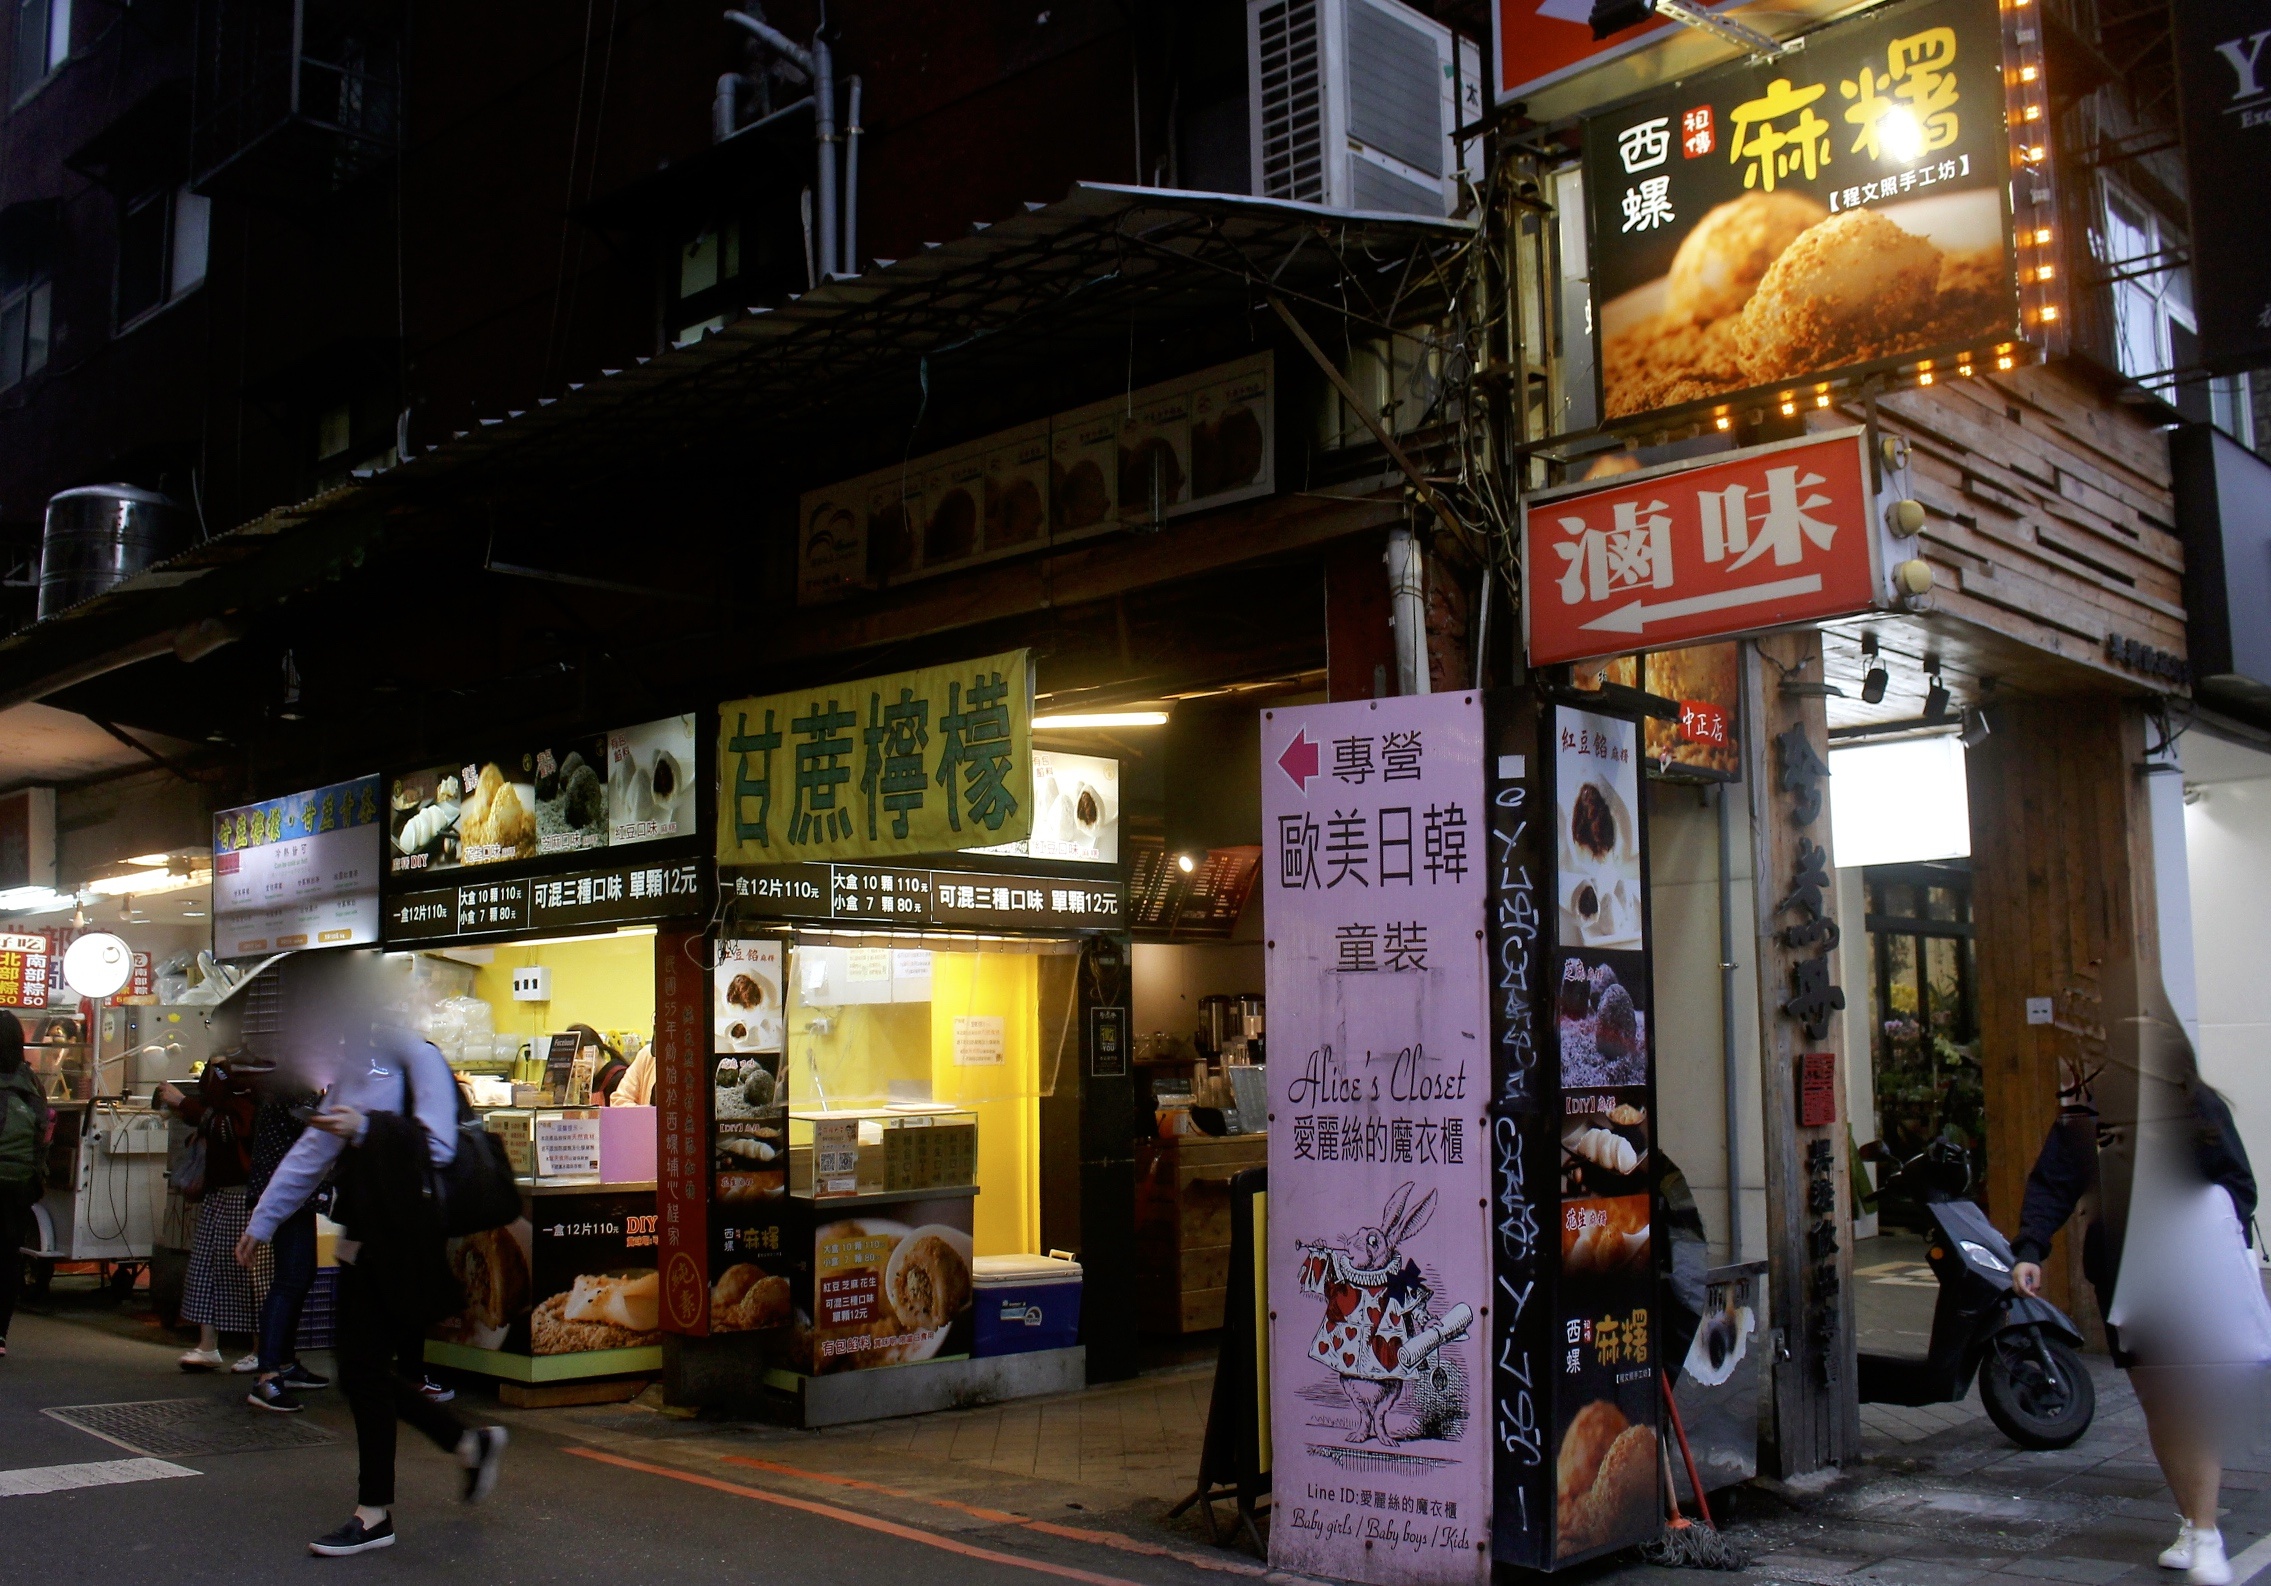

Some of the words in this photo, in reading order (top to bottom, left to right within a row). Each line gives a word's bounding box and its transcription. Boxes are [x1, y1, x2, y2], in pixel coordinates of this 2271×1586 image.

[1730, 27, 1959, 192] 麻糬
[1684, 110, 1711, 154] 祖傳
[1618, 117, 1675, 233] 西螺
[1554, 465, 1837, 606] 滷味
[1683, 707, 1723, 742] 中正店
[1332, 731, 1423, 784] 專營
[1562, 727, 1607, 760] 紅豆餡
[727, 672, 1018, 849] 甘蔗檸檬
[411, 853, 428, 869] DIY
[1277, 803, 1468, 890] 歐美日韓
[461, 890, 476, 906] 大盒
[479, 890, 488, 903] 10
[490, 887, 498, 902] 顆
[501, 886, 521, 901] 110元
[535, 874, 622, 909] 可混三種口味
[629, 866, 697, 899] 單顆12元
[834, 872, 858, 891] 大盒
[863, 875, 877, 889] 10
[881, 875, 893, 892] 顆
[898, 876, 928, 894] 110元
[939, 883, 1043, 912] 可混三種口味
[1051, 889, 1118, 915] 單顆12元
[393, 903, 447, 924] 一盒12片110元
[460, 908, 475, 925] 小盒
[480, 909, 485, 923] 7
[490, 906, 498, 921] 顆
[499, 906, 516, 920] 80元
[834, 894, 858, 912] 小盒
[866, 896, 873, 911] 7
[882, 895, 893, 912] 顆
[898, 896, 921, 913] 80元
[1335, 922, 1429, 974] 童裝
[23, 954, 47, 996] 南部粽
[23, 997, 44, 1006] 50
[1288, 1046, 1380, 1109] Alice's
[1391, 1043, 1466, 1101] Closet
[1294, 1115, 1463, 1165] 愛麗絲的魔衣櫃
[543, 1222, 619, 1236] 一盒12片110元
[627, 1215, 658, 1234] DIY
[1566, 1209, 1587, 1231] 花生
[823, 1281, 840, 1292] 紅豆
[860, 1277, 877, 1288] 花生
[826, 1294, 875, 1309] 可混三種口味
[832, 1308, 868, 1322] 單顆12元
[822, 1334, 872, 1356] 有包餡料
[1566, 1319, 1582, 1374] 西螺
[1595, 1308, 1648, 1366] 麻糬
[1307, 1483, 1335, 1501] Line
[1291, 1508, 1324, 1539] Baby
[1327, 1514, 1352, 1541] girls
[1365, 1518, 1399, 1549] Baby
[1403, 1521, 1427, 1552] boys
[1440, 1526, 1470, 1551] Kids
